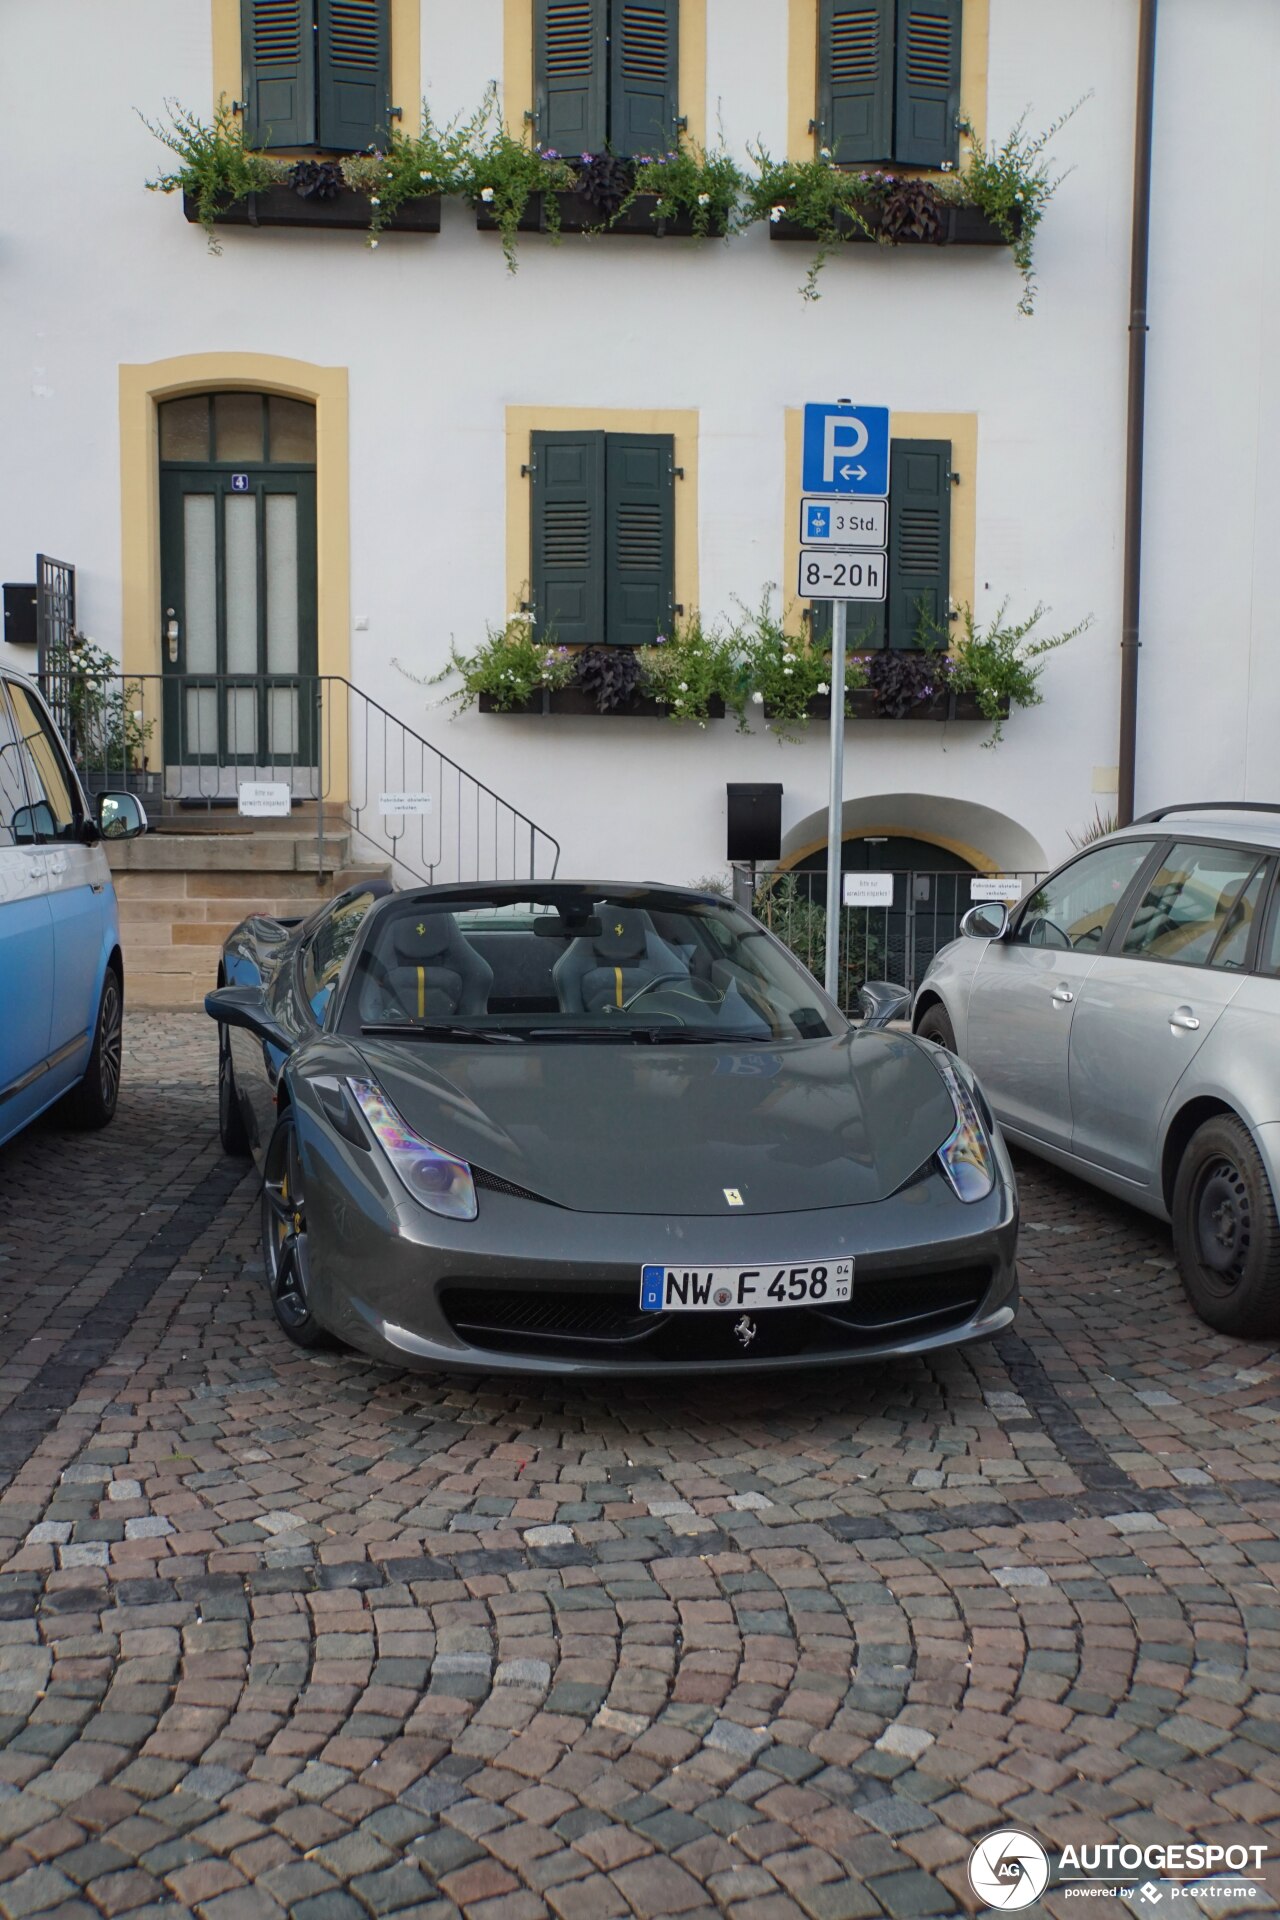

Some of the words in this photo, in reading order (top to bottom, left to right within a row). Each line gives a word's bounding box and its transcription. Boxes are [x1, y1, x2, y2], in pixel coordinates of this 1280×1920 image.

[822, 415, 869, 482] P
[235, 476, 244, 489] 4
[836, 516, 845, 530] 3
[849, 516, 878, 532] Std.
[836, 1265, 849, 1275] 04
[648, 1292, 656, 1302] D
[665, 1272, 713, 1305] NW
[737, 1271, 760, 1304] F
[767, 1266, 829, 1302] 458
[836, 1286, 848, 1297] 10
